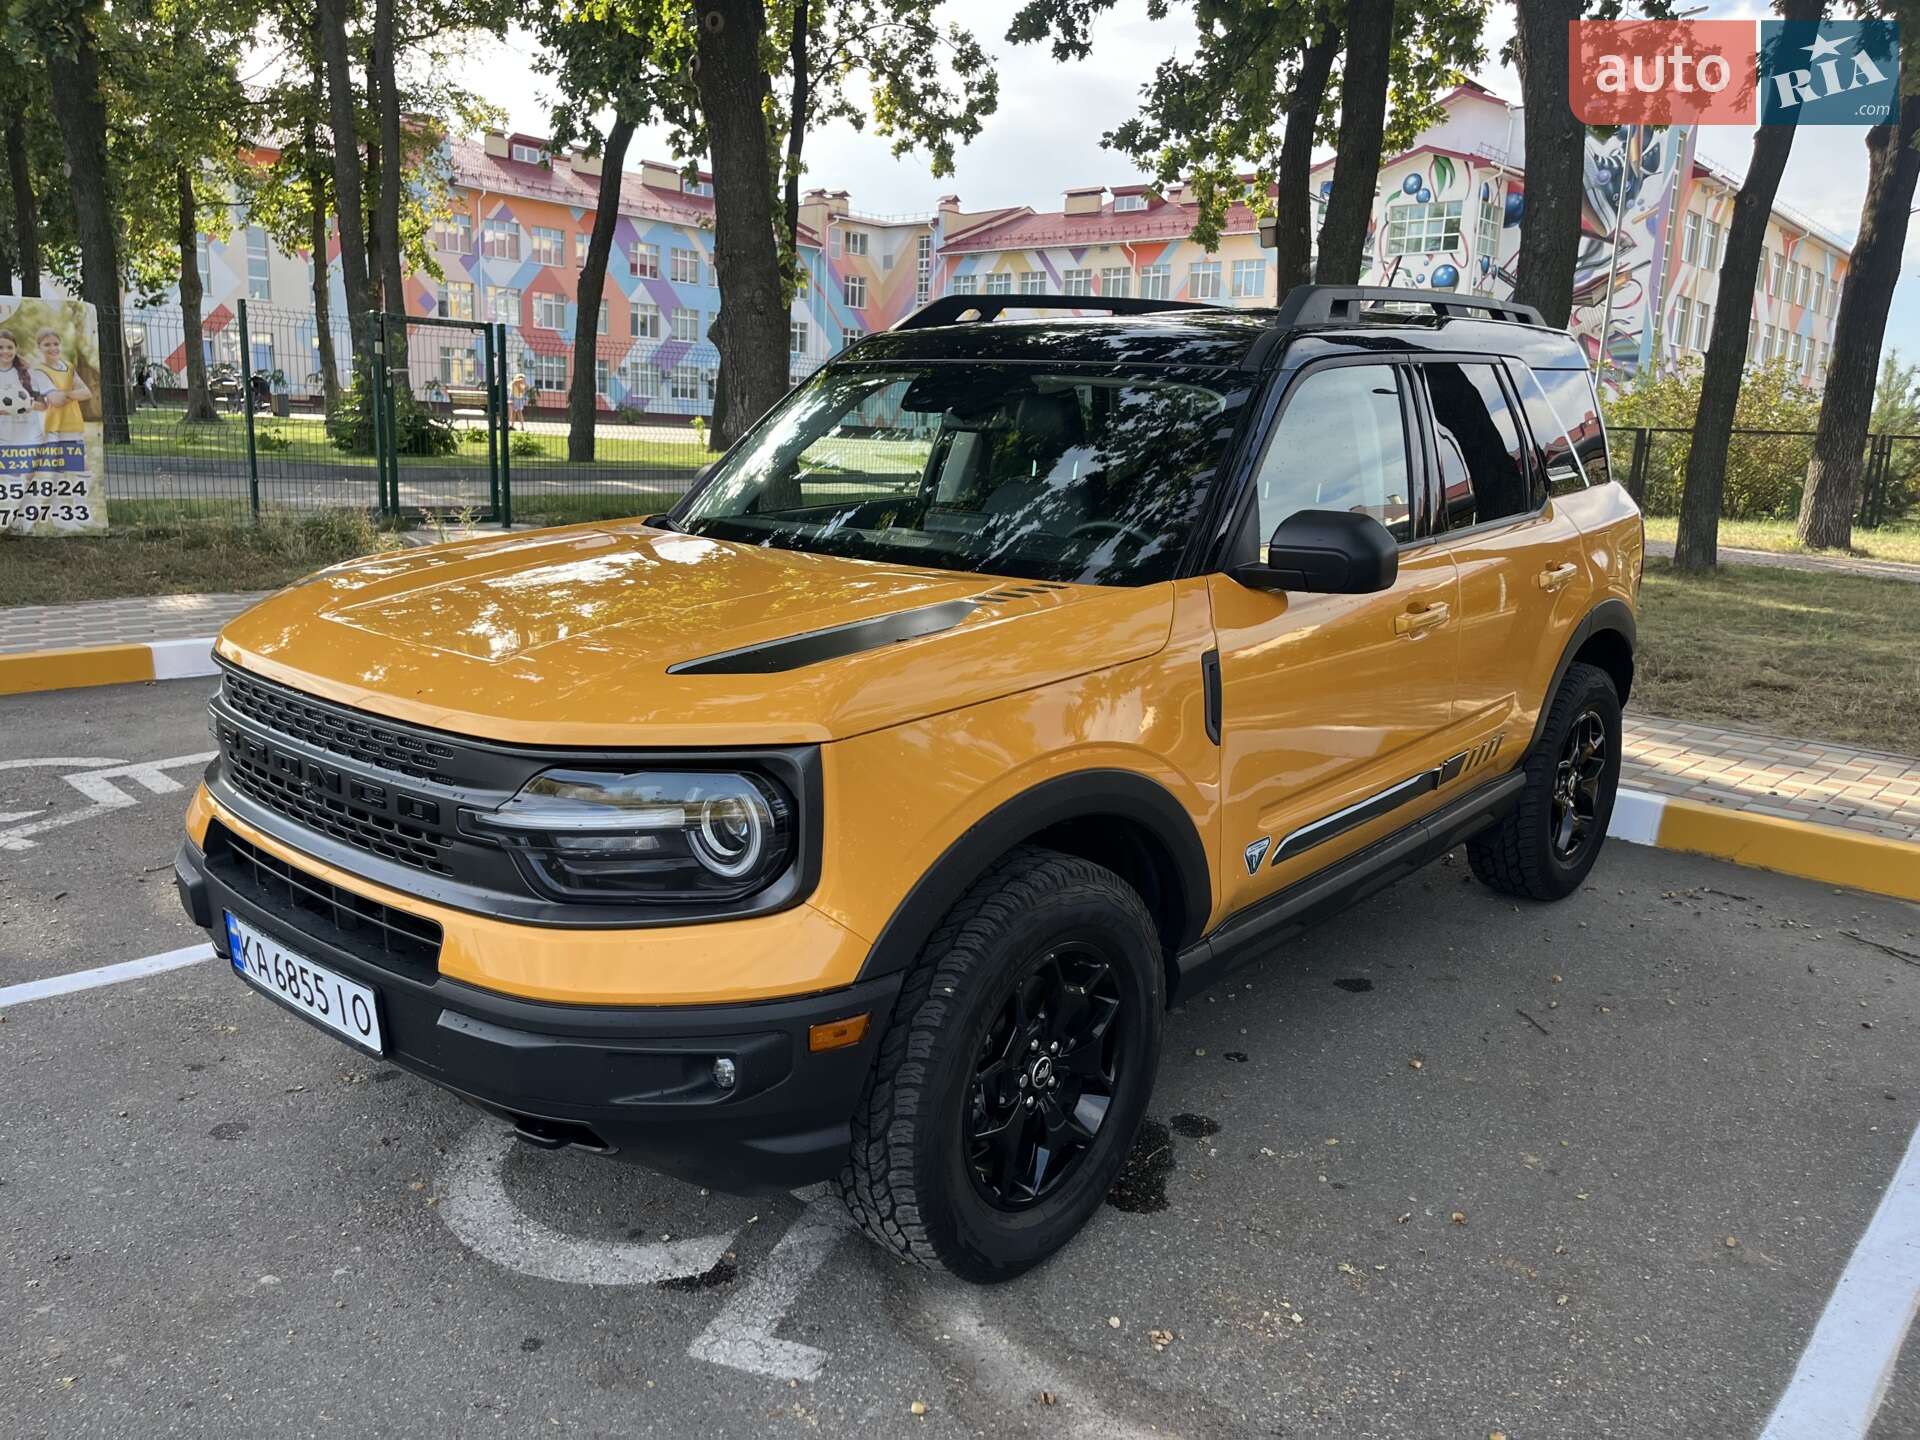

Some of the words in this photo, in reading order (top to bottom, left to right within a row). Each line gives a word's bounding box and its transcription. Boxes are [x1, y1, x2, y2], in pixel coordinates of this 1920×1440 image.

[67, 447, 82, 455] ТА
[220, 723, 440, 825] BRONCO
[239, 929, 272, 984] KA
[274, 953, 330, 1016] 6855
